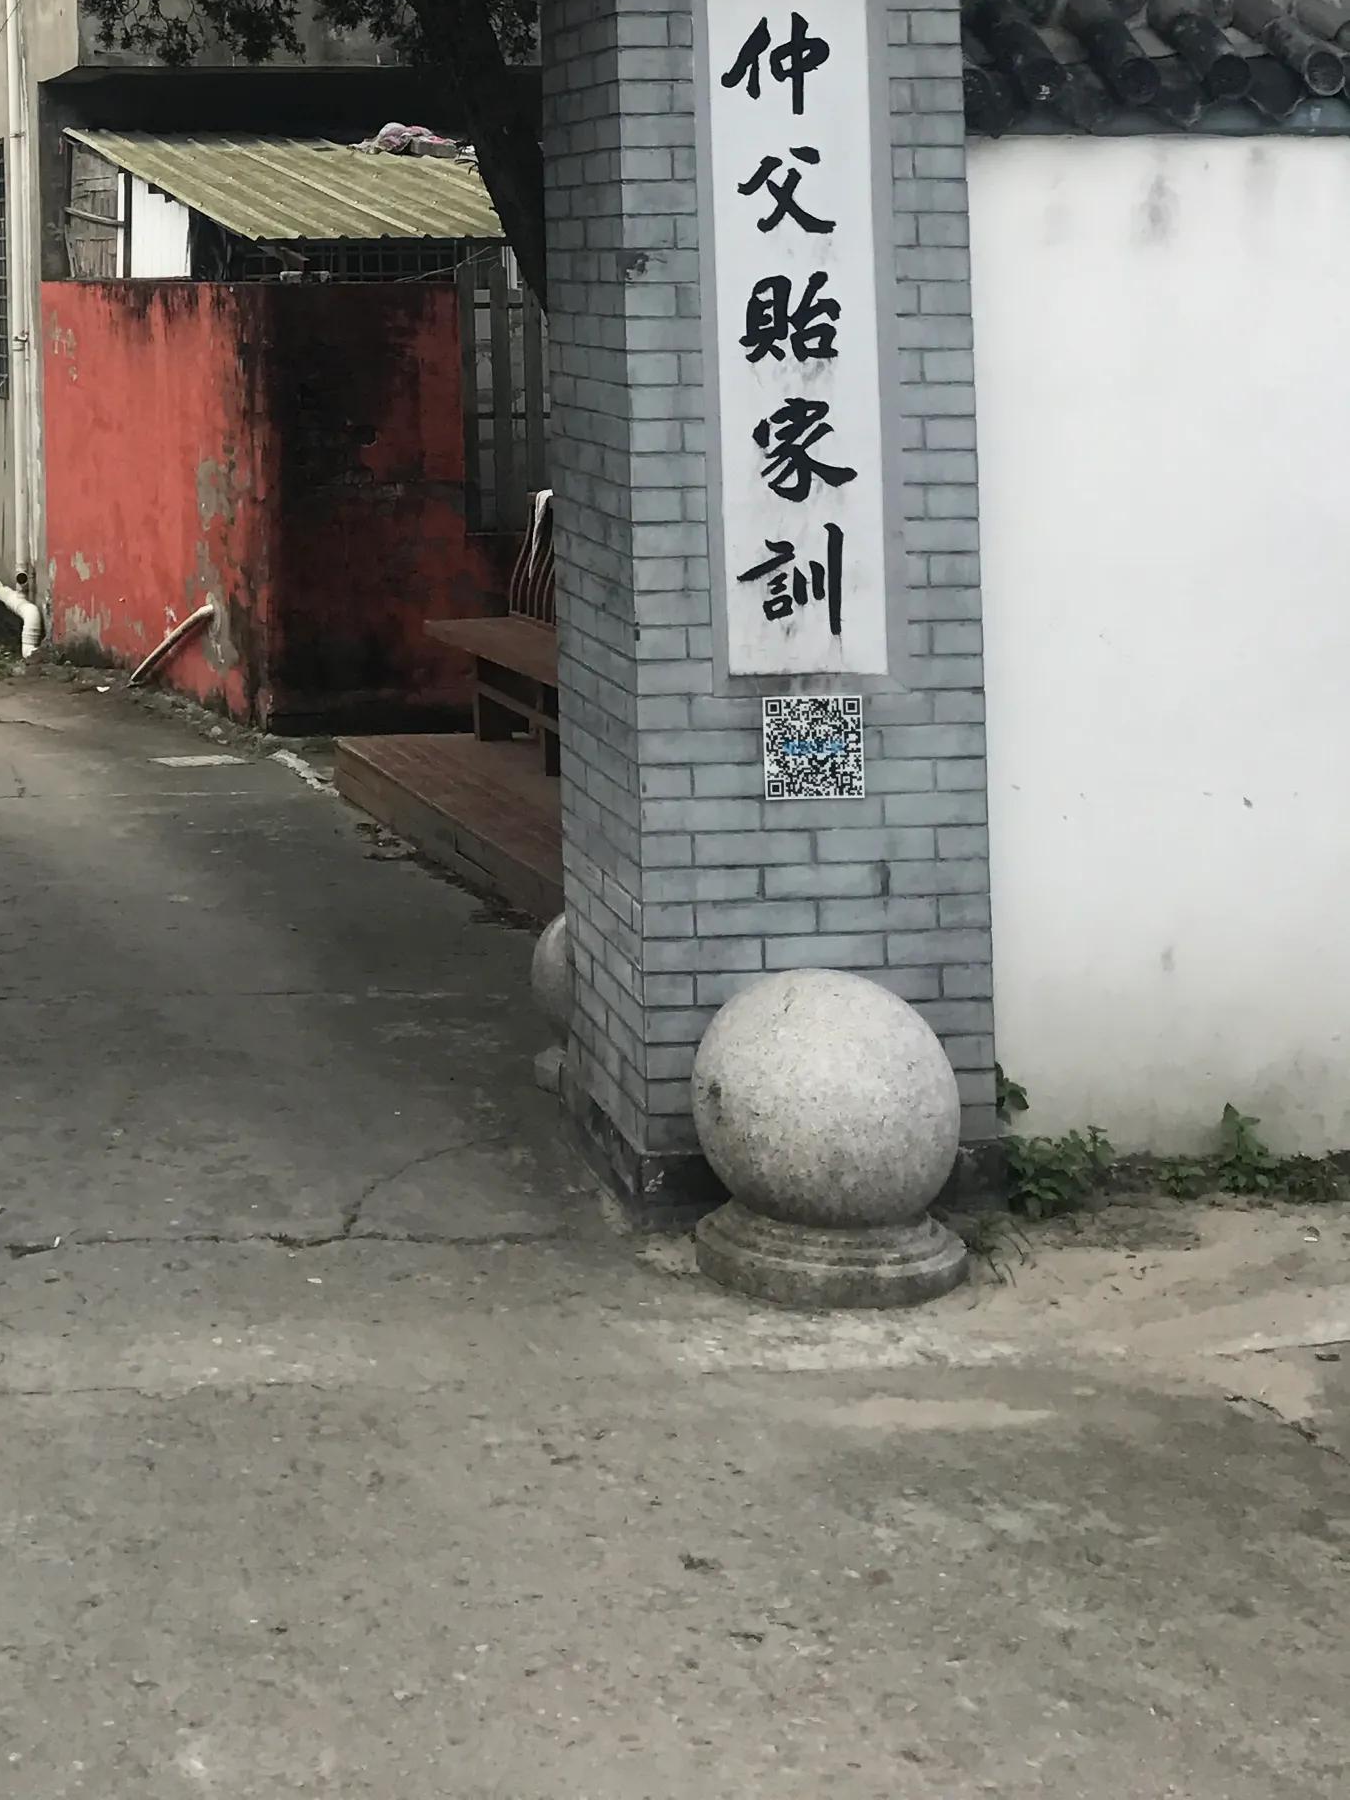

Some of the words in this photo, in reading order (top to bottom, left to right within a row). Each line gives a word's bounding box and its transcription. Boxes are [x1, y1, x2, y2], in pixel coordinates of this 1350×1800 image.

[720, 11, 858, 637] 仲父貽家訓
